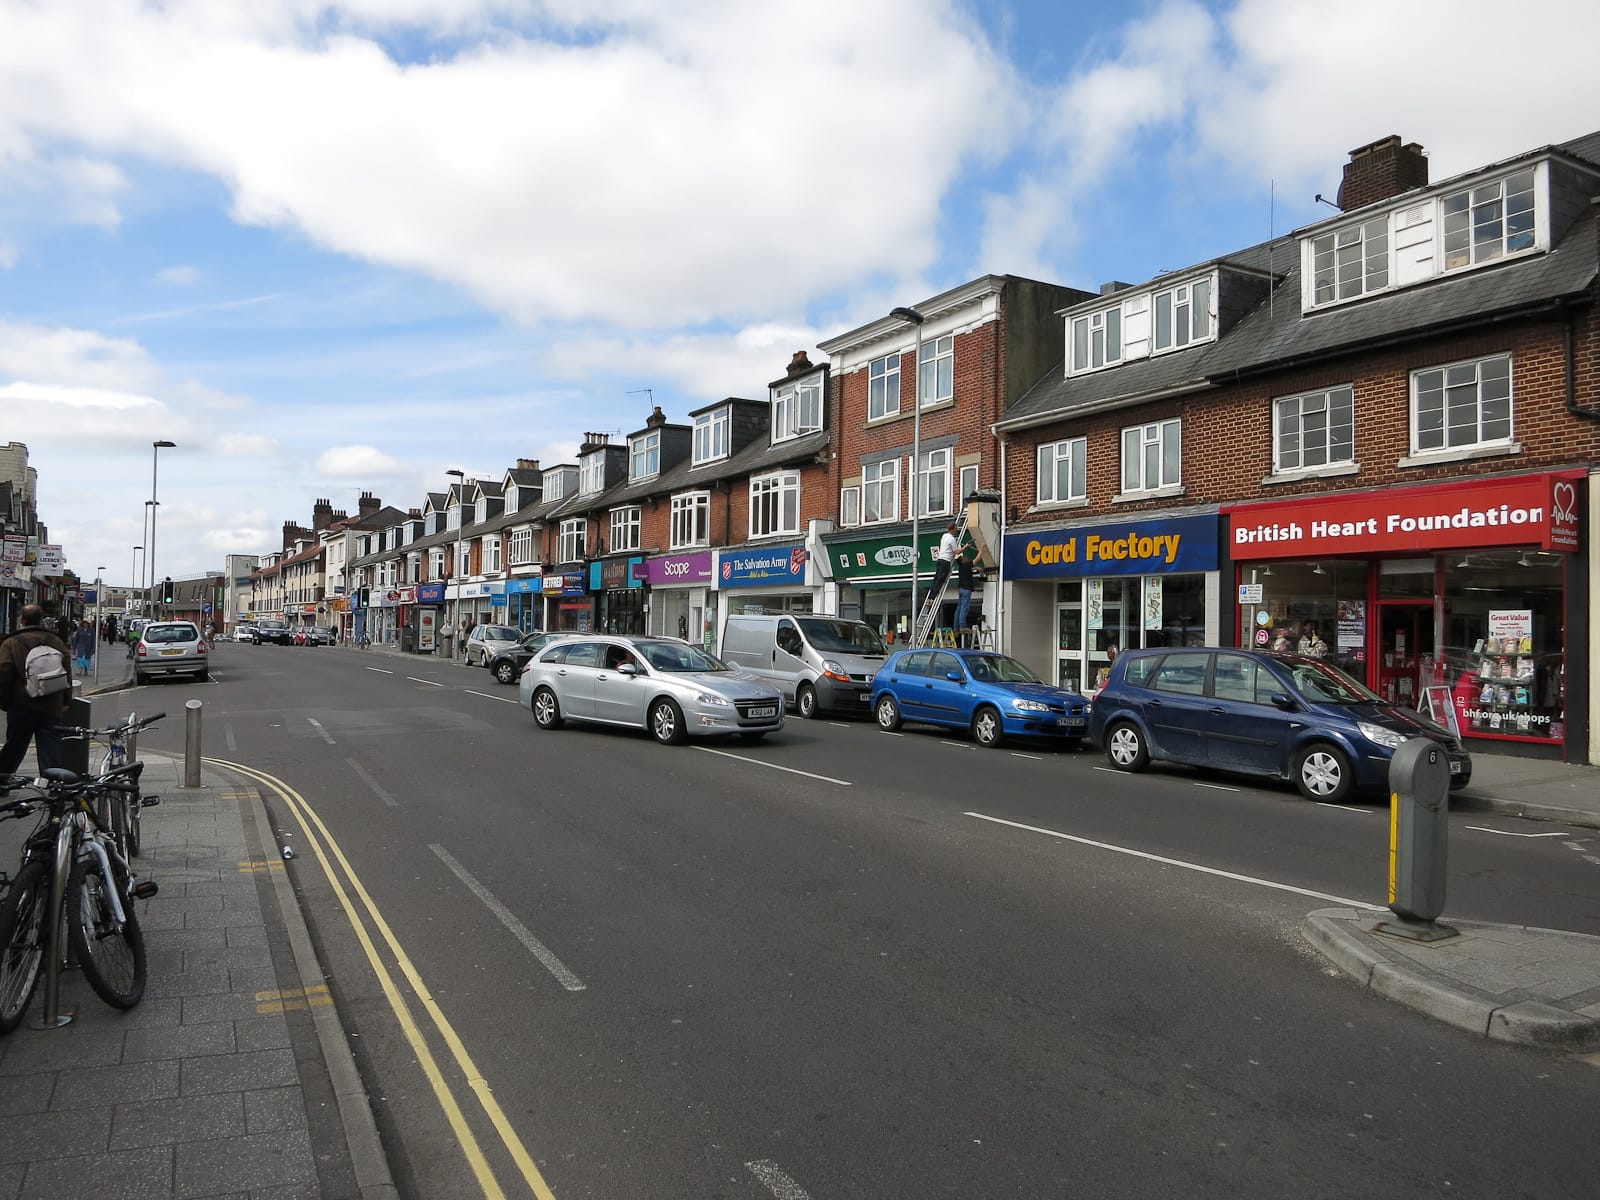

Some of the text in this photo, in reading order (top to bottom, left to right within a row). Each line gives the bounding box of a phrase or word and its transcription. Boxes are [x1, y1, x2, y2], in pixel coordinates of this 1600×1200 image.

[1235, 504, 1543, 544] British Heart Foundation
[1026, 532, 1181, 566] Card Factory
[664, 560, 690, 578] Scope
[734, 556, 787, 571] The Salvation Army
[1429, 751, 1436, 763] 6
